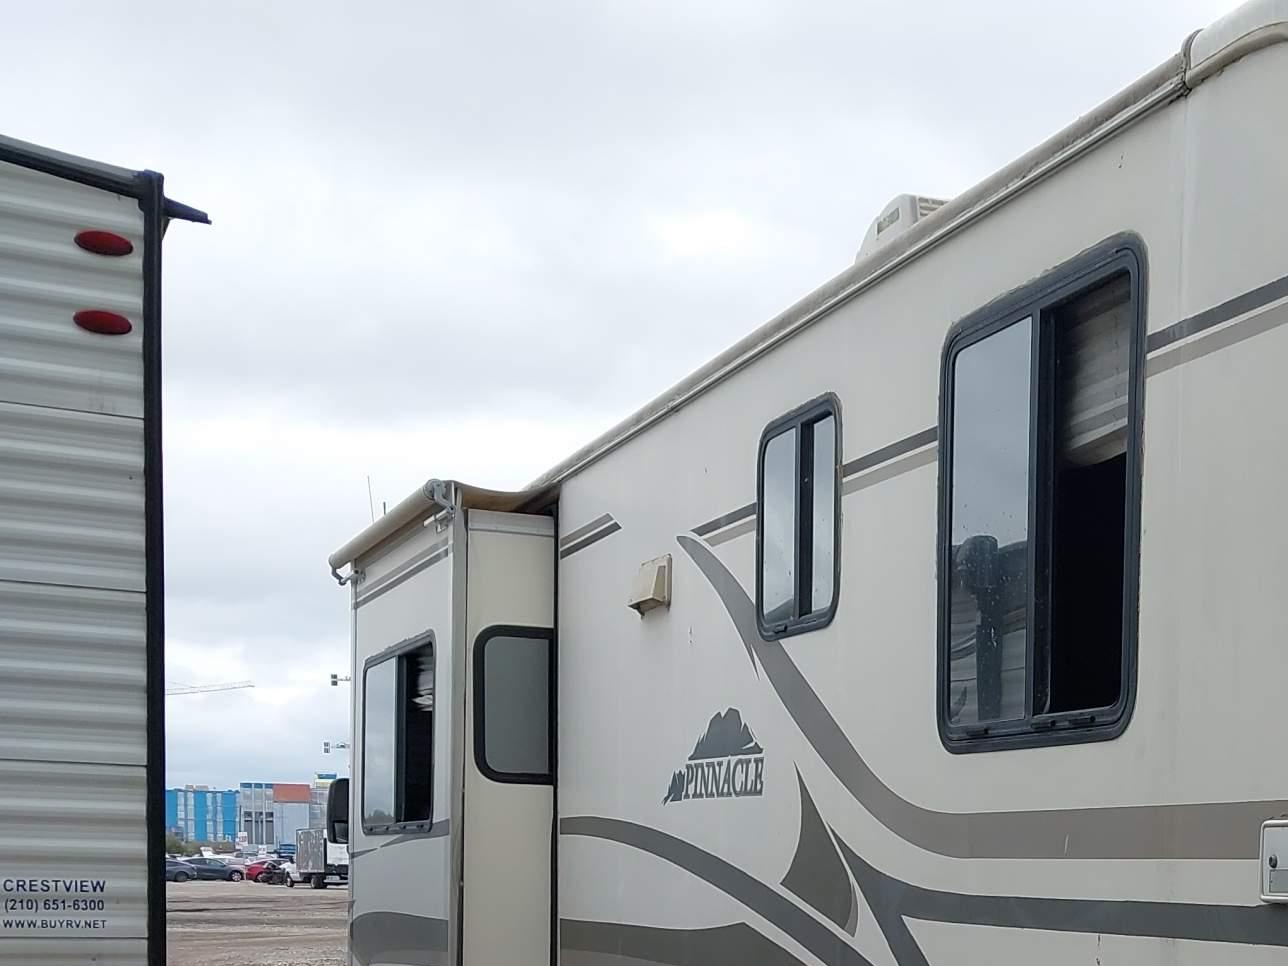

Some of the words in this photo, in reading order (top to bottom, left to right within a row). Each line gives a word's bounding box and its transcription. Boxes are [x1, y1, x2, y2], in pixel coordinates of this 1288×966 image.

[683, 757, 765, 799] PINNACLE
[3, 879, 106, 893] CRESTVIEW
[4, 899, 39, 913] (210)
[43, 899, 105, 912] 651-6300
[3, 919, 107, 929] WWW.BUYRV.NET
